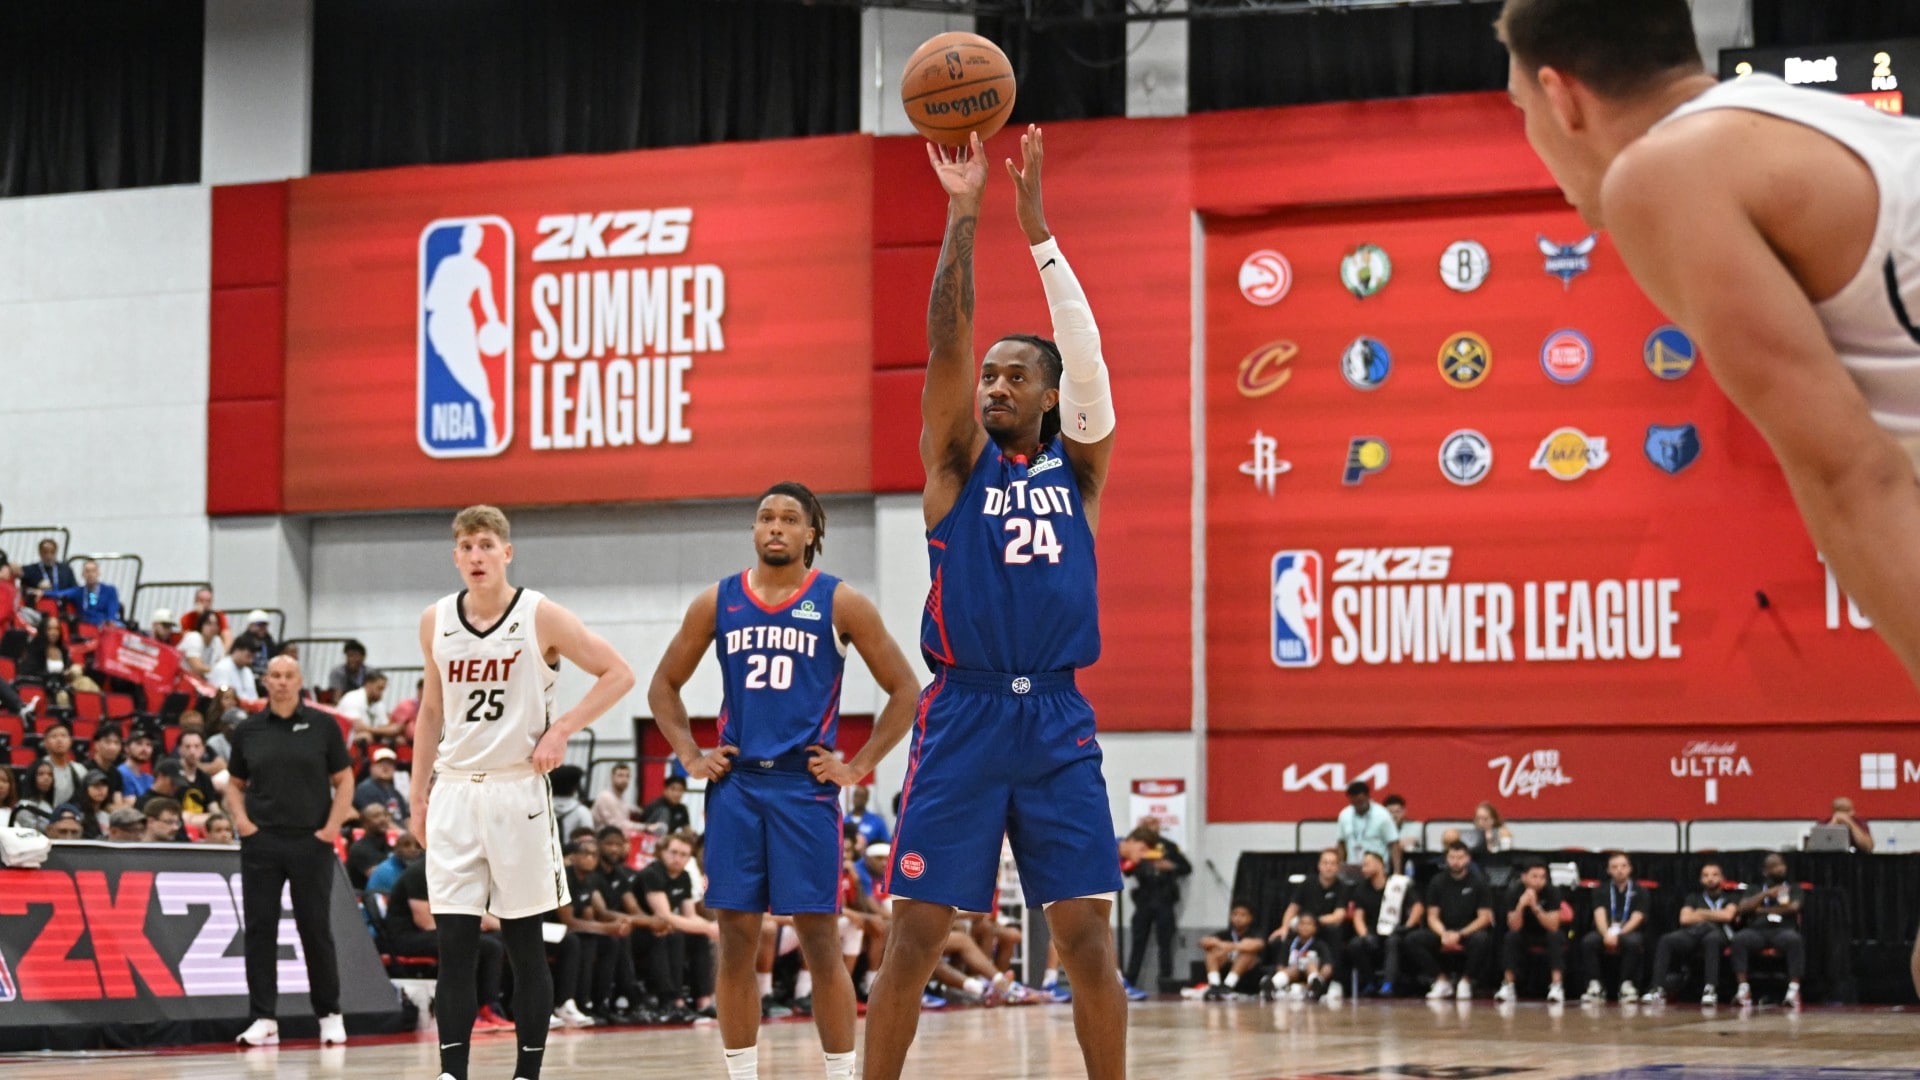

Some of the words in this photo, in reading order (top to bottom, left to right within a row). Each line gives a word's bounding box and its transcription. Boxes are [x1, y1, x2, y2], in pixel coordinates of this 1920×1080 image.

[1873, 52, 1891, 77] 2
[925, 87, 1000, 117] Wilson
[532, 207, 693, 262] 2K26
[531, 264, 725, 360] SUMMER
[530, 355, 692, 450] LEAGUE
[432, 402, 477, 441] NBA
[983, 480, 1073, 517] DETOIT
[1004, 518, 1062, 564] 24
[1331, 546, 1452, 582] 2K26
[1331, 581, 1515, 664] SUMMER
[1524, 578, 1682, 661] LEAGUE
[725, 626, 818, 658] DETROIT
[448, 649, 521, 683] HEAT
[745, 654, 793, 690] 20
[466, 689, 504, 722] 25
[1283, 763, 1388, 791] KIA
[1488, 753, 1573, 798] Vegas
[1670, 756, 1753, 777] ULTRA
